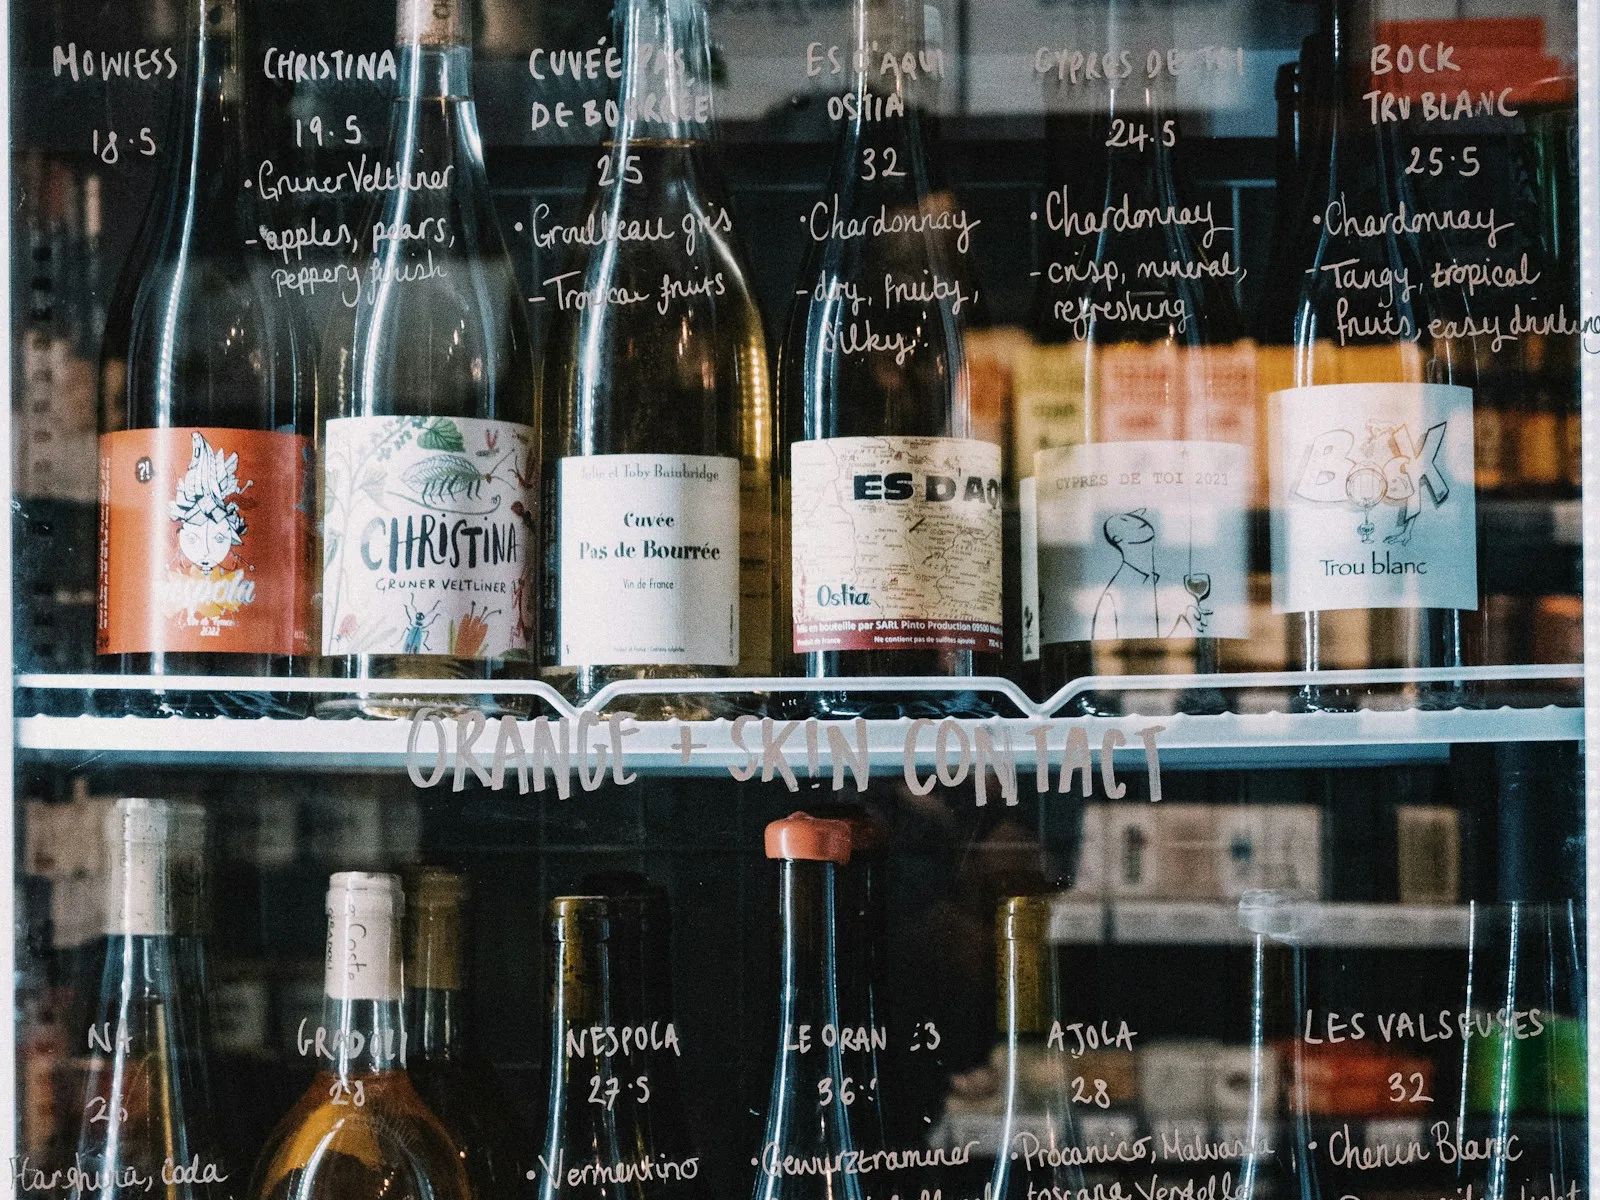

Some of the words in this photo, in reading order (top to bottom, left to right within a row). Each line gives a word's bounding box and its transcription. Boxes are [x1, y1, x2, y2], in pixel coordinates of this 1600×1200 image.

[264, 47, 397, 81] CHRISTINA
[529, 36, 622, 80] CUVÉE
[807, 42, 842, 77] ES
[1370, 42, 1462, 75] BOCK
[532, 101, 574, 130] DE
[827, 92, 904, 121] OSTIA
[1421, 87, 1518, 121] BLANC
[597, 154, 644, 187] 25
[861, 148, 907, 180] 32
[809, 194, 980, 253] Chardonnay
[1045, 185, 1234, 248] Chardonnay
[1324, 191, 1515, 248] Chardonnay
[1431, 253, 1540, 296] tropical
[1428, 314, 1518, 354] easy
[854, 472, 914, 501] ES
[1119, 472, 1141, 485] DE
[1153, 472, 1183, 485] TOI
[1195, 473, 1228, 486] 2023
[624, 512, 675, 528] Cuvée
[580, 541, 607, 560] Pas
[614, 541, 635, 559] de
[643, 539, 720, 560] Bourrée
[1320, 558, 1364, 577] Trou
[1372, 551, 1427, 575] blanc
[376, 578, 435, 590] GRUNER
[623, 578, 634, 589] Vin
[637, 578, 646, 589] de
[649, 578, 674, 590] France
[817, 583, 871, 607] Ostia
[858, 623, 873, 633] par
[876, 620, 898, 630] SARL
[901, 620, 925, 630] Pinto
[928, 621, 970, 632] Production
[926, 635, 934, 644] de
[405, 708, 640, 799] ORANGE
[729, 714, 869, 793] SKIN
[904, 716, 1167, 806] CONTACT
[88, 1018, 133, 1056] NA
[567, 1021, 680, 1058] NESPOLA
[784, 1024, 811, 1054] LE
[1047, 1020, 1138, 1059] AJOLA
[1304, 1009, 1365, 1044] LES
[1377, 1008, 1544, 1043] VALSEUSES
[297, 1018, 408, 1070] GRADOLI
[329, 1080, 365, 1107] 28
[1071, 1076, 1111, 1109] 28
[1388, 1072, 1434, 1103] 32
[762, 1141, 980, 1177] Gewurztraminer
[1329, 1124, 1430, 1170] Chenin
[1431, 1116, 1523, 1164] Blanc
[538, 1149, 699, 1189] Vermentino
